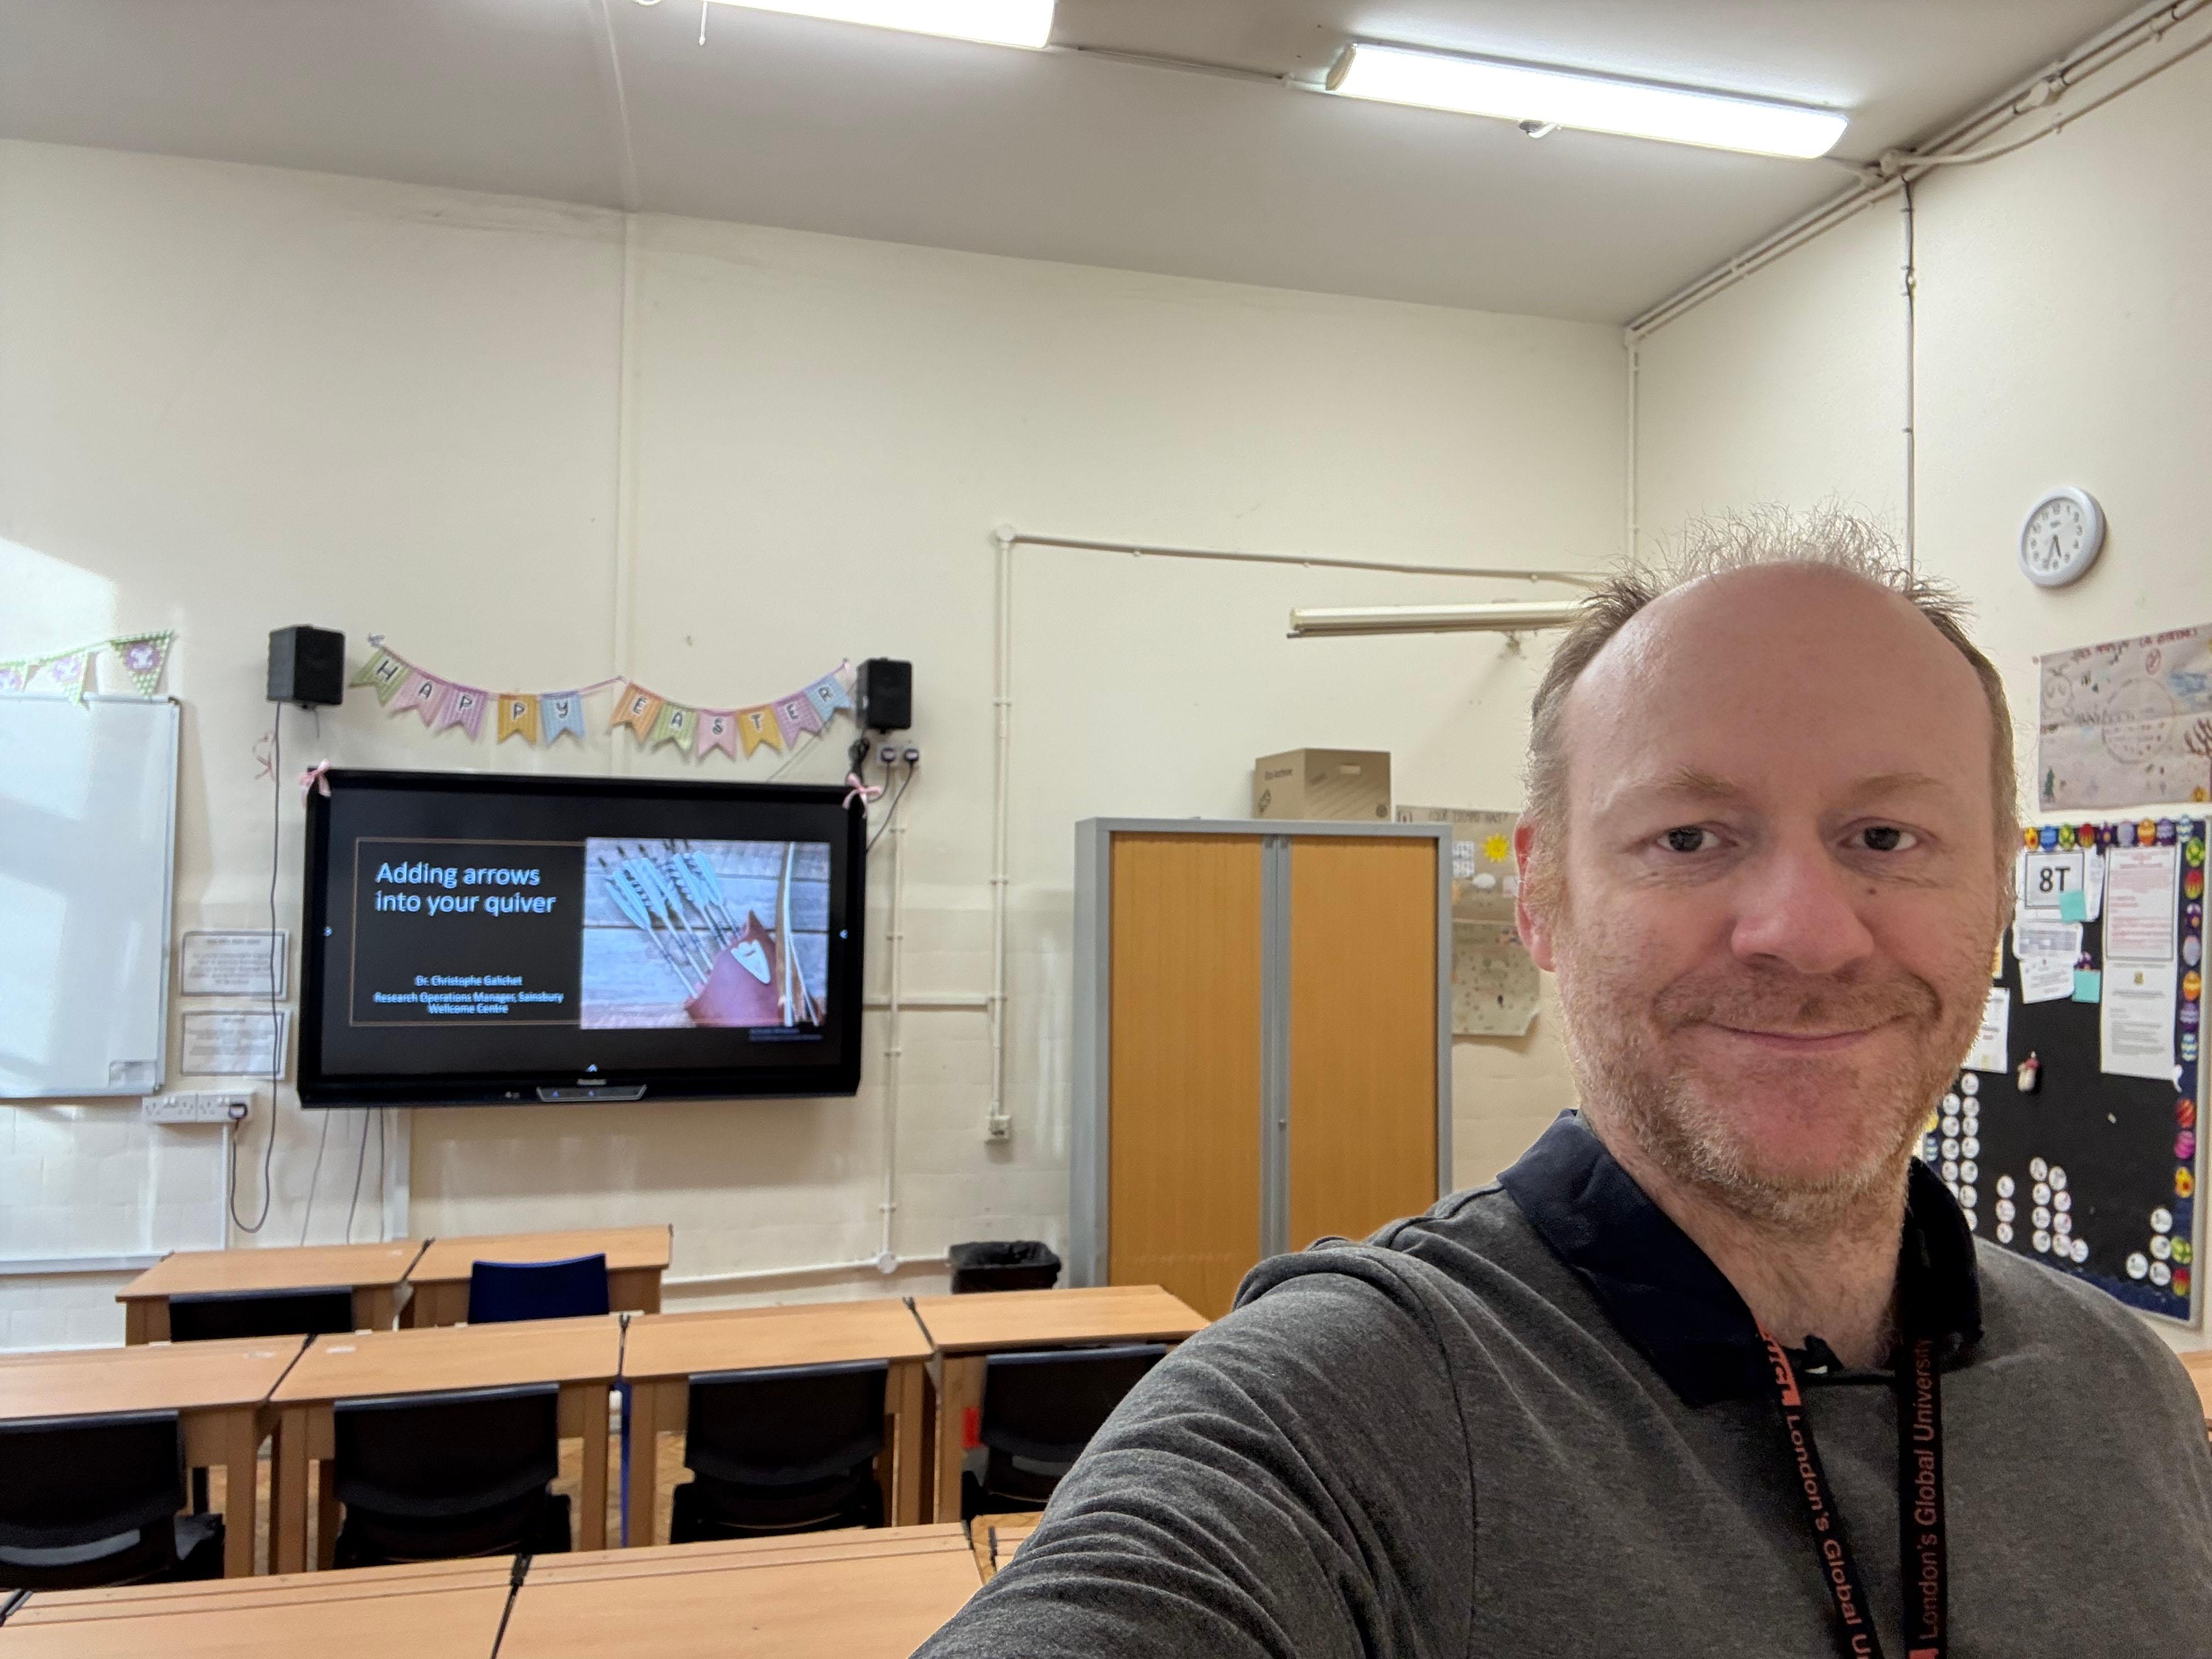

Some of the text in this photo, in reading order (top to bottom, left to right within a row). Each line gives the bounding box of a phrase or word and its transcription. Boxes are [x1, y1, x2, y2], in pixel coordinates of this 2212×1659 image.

[377, 660, 834, 735] HAPPY EASTER
[375, 861, 540, 889] Adding arrows
[2040, 867, 2070, 892] 8T
[375, 890, 557, 917] into your quiver
[431, 975, 483, 988] Christophe
[374, 992, 418, 1003] Research
[419, 992, 472, 1005] Operations
[518, 992, 565, 1003] Sainsbury
[428, 1003, 509, 1014] Wellcome Centre
[1914, 1449, 1938, 1526] Global
[1786, 1415, 1830, 1532] London's
[1823, 1539, 1863, 1624] Global
[1917, 1534, 1939, 1640] London's
